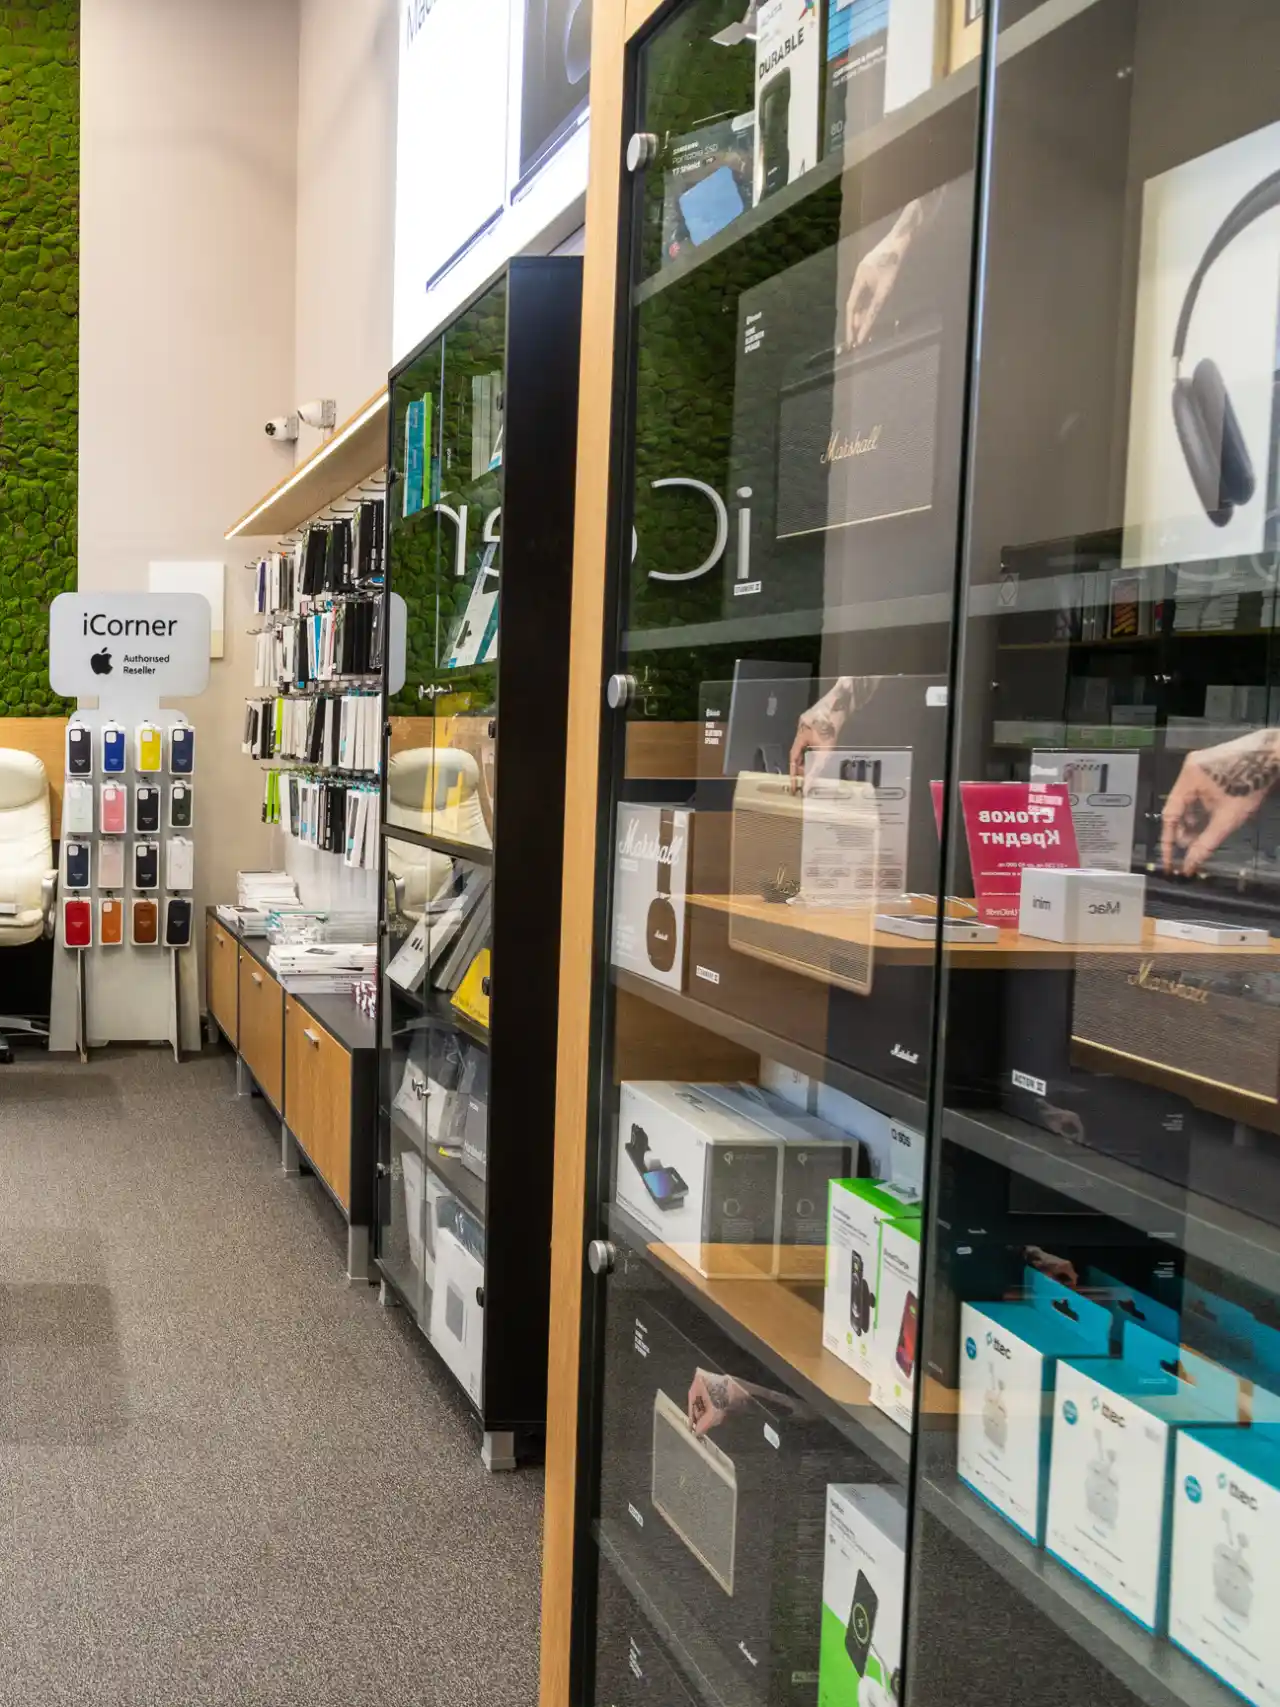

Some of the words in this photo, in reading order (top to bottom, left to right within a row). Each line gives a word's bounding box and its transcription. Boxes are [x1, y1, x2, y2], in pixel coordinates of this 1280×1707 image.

[759, 26, 805, 79] DURABLE
[820, 424, 883, 464] Marshall
[83, 612, 178, 637] iCorner
[123, 654, 170, 663] Authorised
[123, 666, 156, 675] Reseller
[618, 818, 684, 865] Marshall
[993, 1338, 1011, 1360] ttec
[1101, 1402, 1126, 1429] ttec
[1229, 1480, 1258, 1511] ttec
